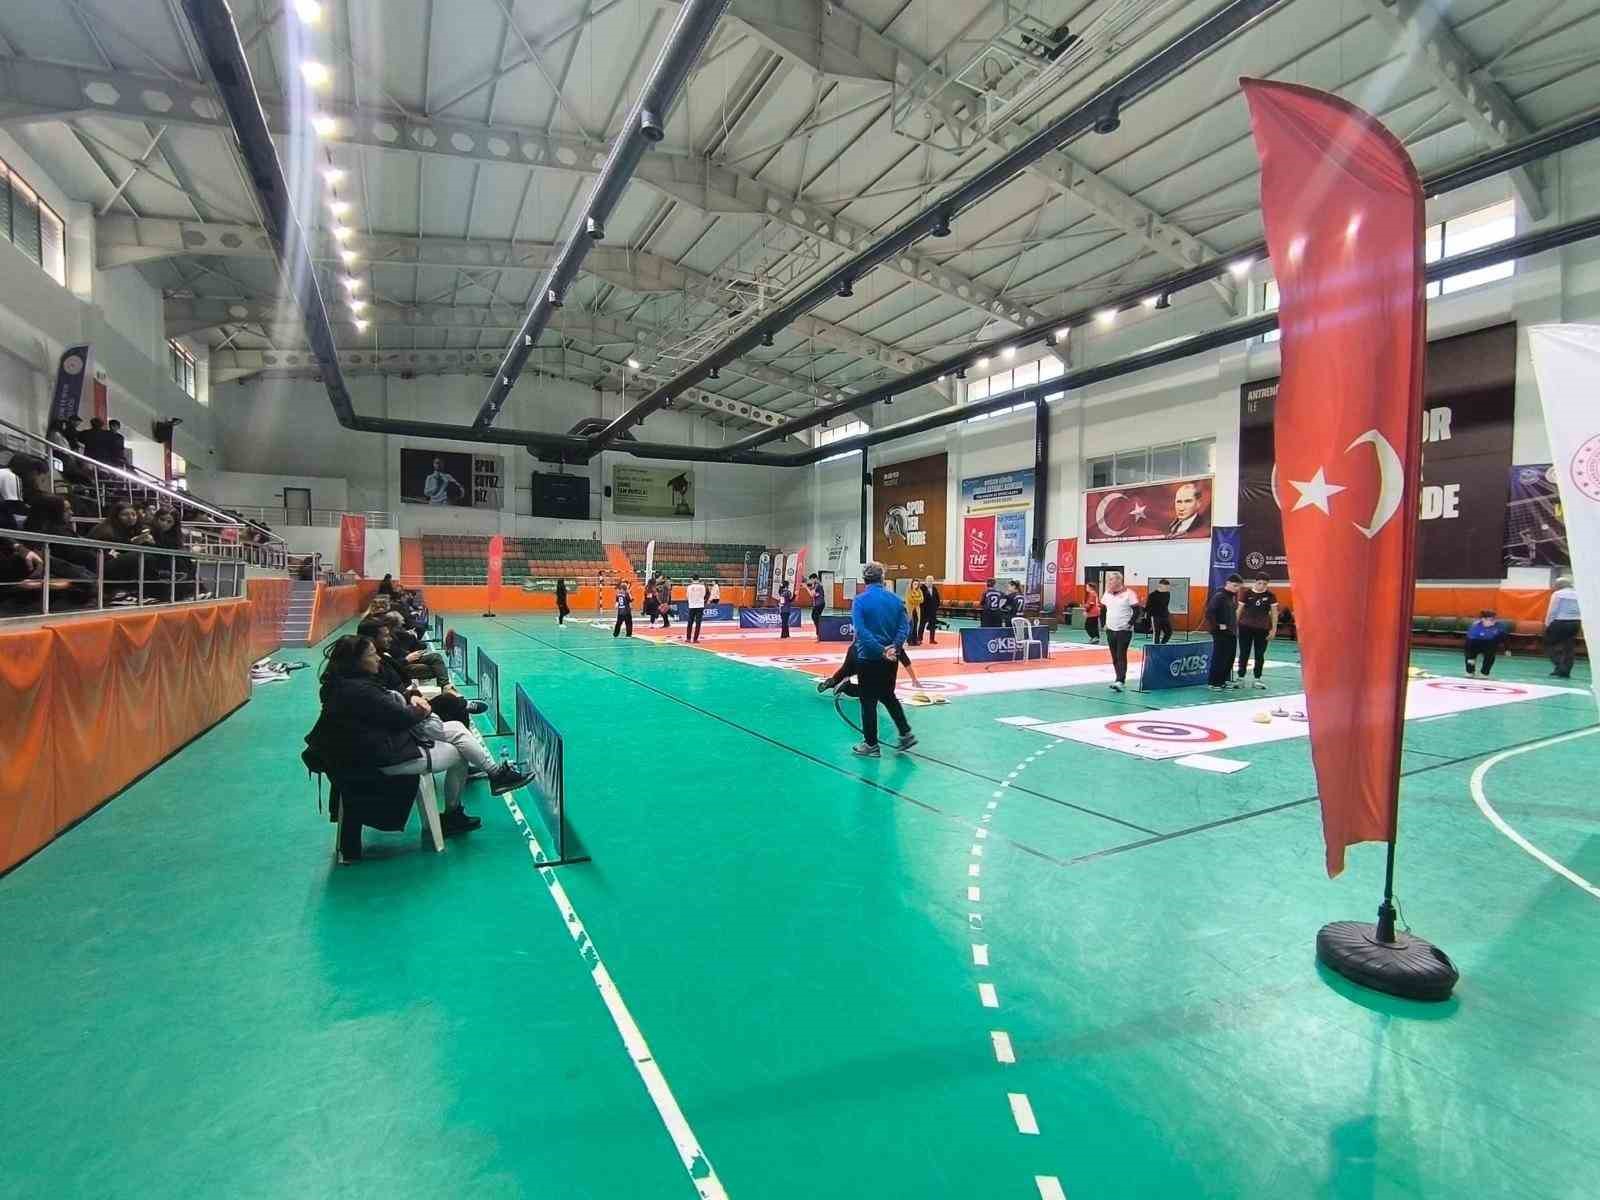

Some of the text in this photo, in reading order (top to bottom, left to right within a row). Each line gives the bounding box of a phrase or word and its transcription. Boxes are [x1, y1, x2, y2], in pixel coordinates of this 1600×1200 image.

[906, 500, 925, 515] SPOR
[969, 554, 987, 565] THF
[1181, 654, 1208, 671] KBS
